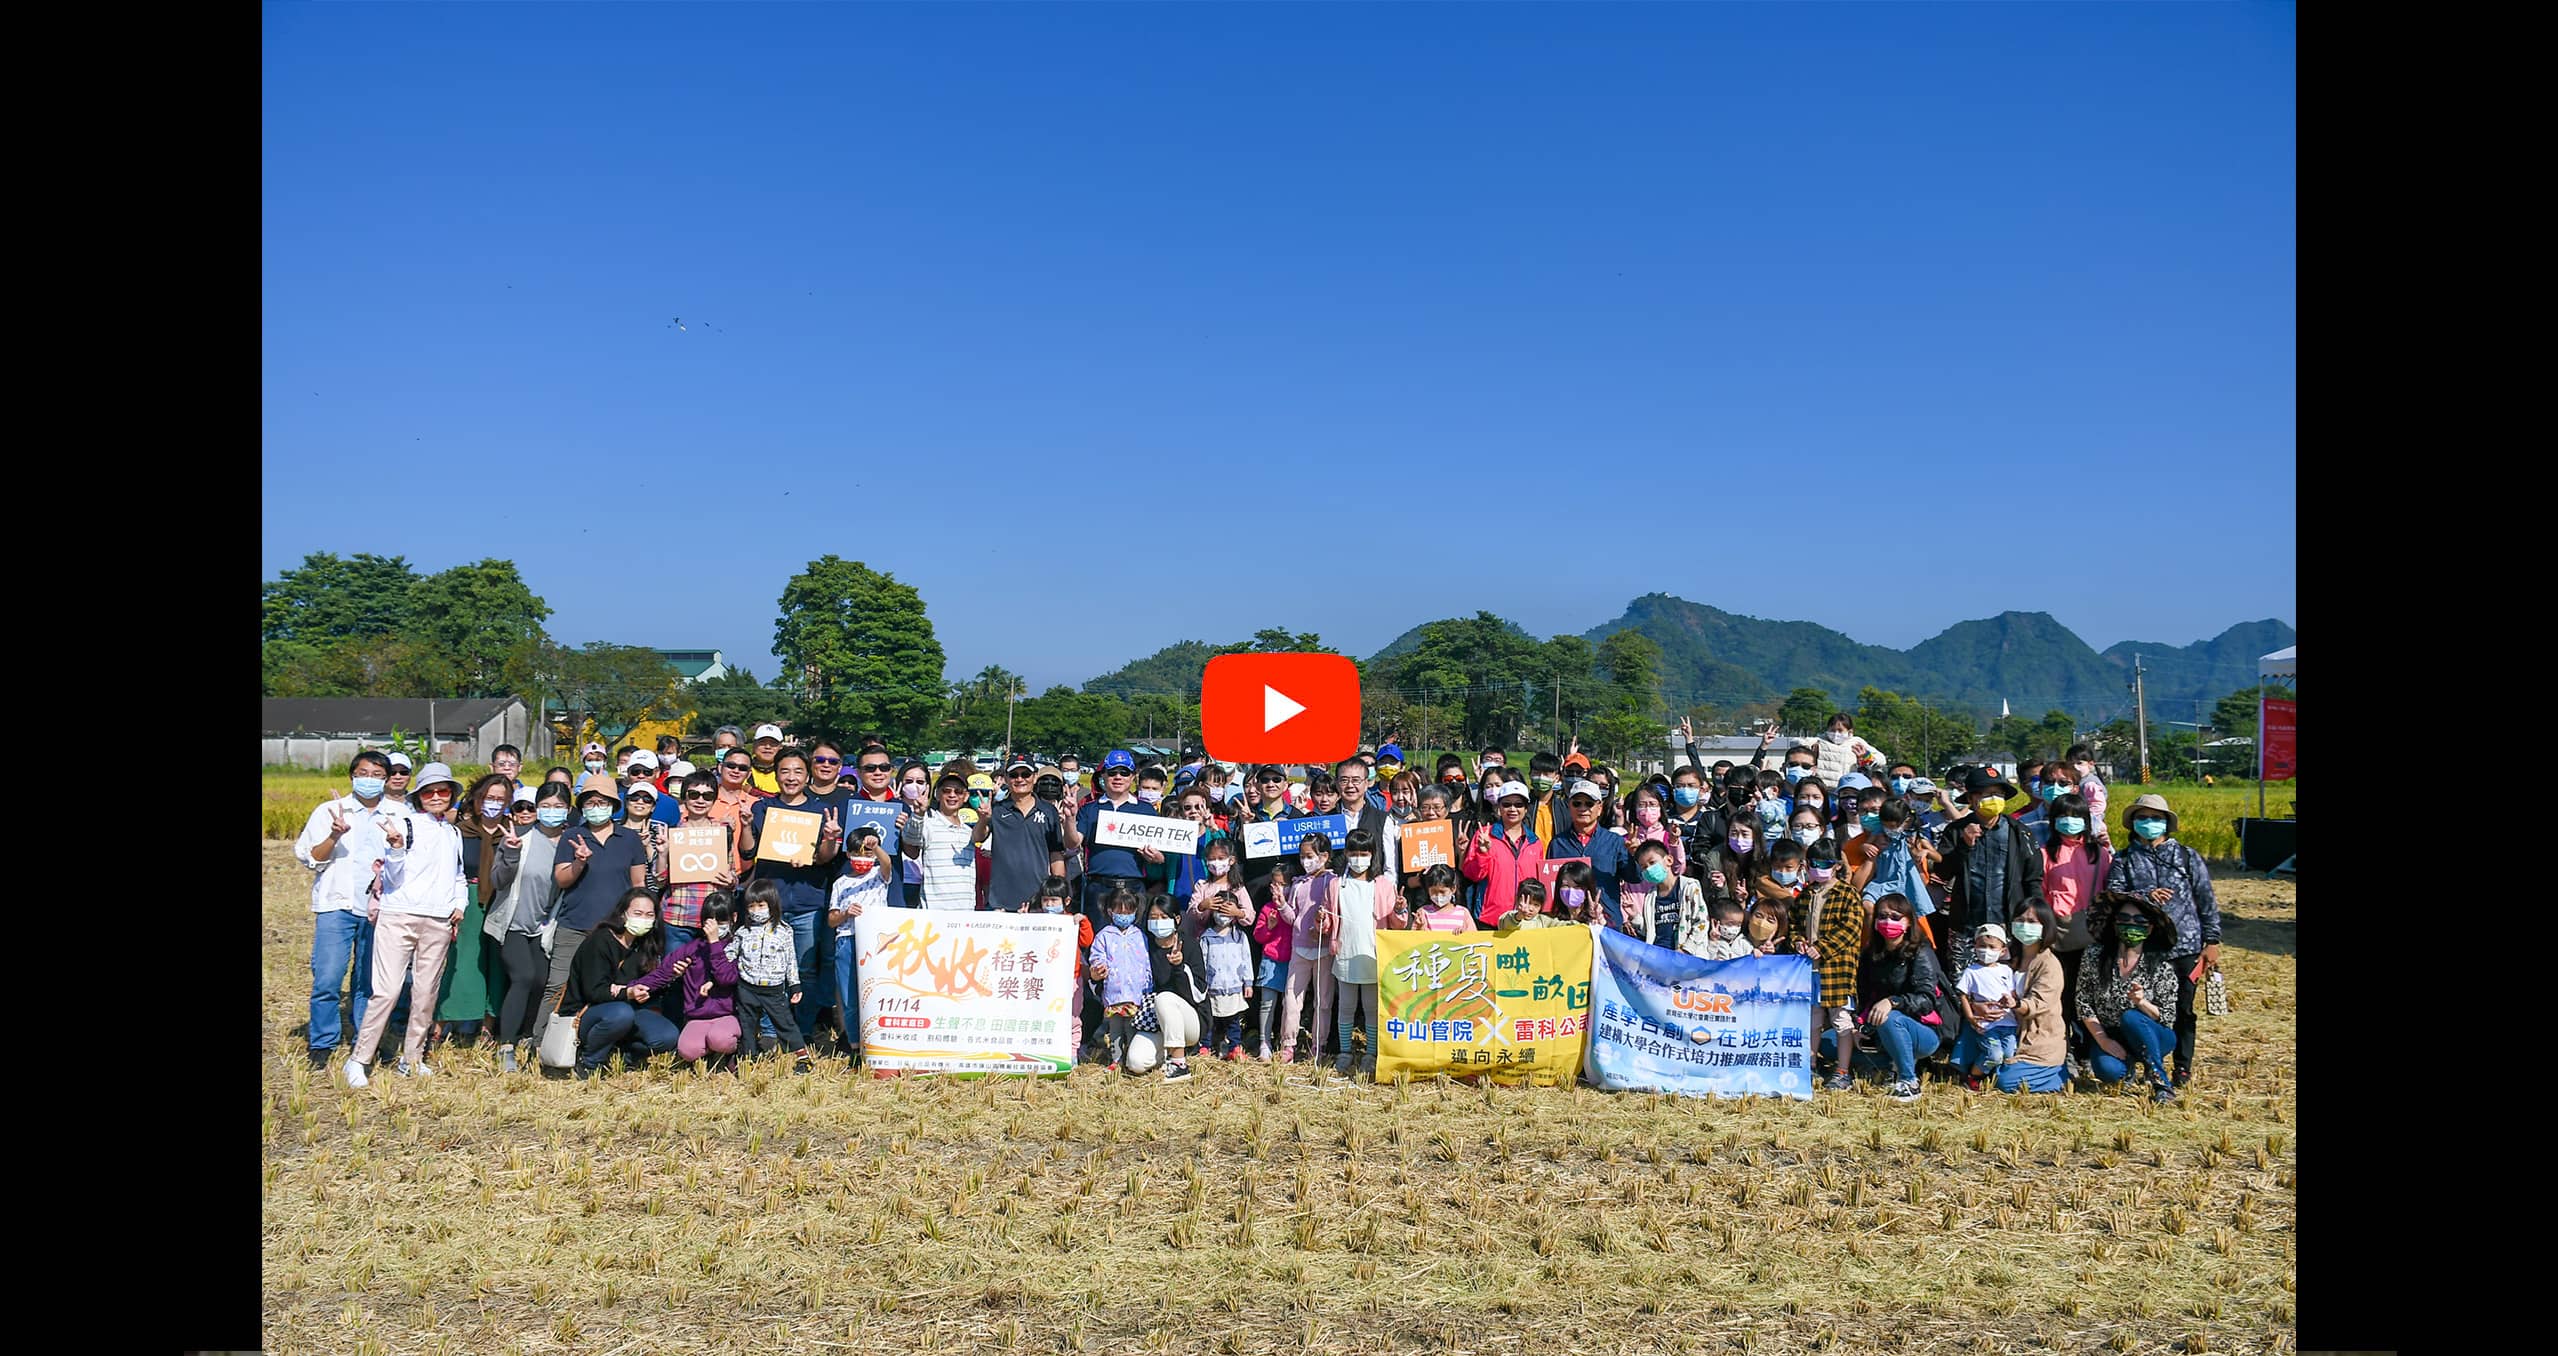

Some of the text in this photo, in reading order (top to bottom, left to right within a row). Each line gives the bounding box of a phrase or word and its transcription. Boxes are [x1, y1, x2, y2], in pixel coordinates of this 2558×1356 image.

[771, 812, 778, 823] 2
[852, 804, 862, 815] 17
[672, 831, 685, 845] 12
[1119, 822, 1194, 841] LASER TEK
[1404, 827, 1413, 838] 11
[1543, 863, 1550, 875] 4
[887, 917, 993, 997] 秋收
[991, 950, 1038, 973] 稻香
[998, 977, 1044, 1000] 樂饗
[1392, 941, 1504, 1016] 種夏
[877, 998, 921, 1012] 11/14
[1672, 988, 1735, 1014] USR
[1386, 1018, 1474, 1042] 中山管院
[1601, 999, 1803, 1049] 產學合創 在地共融
[1451, 1048, 1536, 1064] 邁向永續
[1598, 1022, 1803, 1069] 建構大學合作式培力推廣服務計畫
